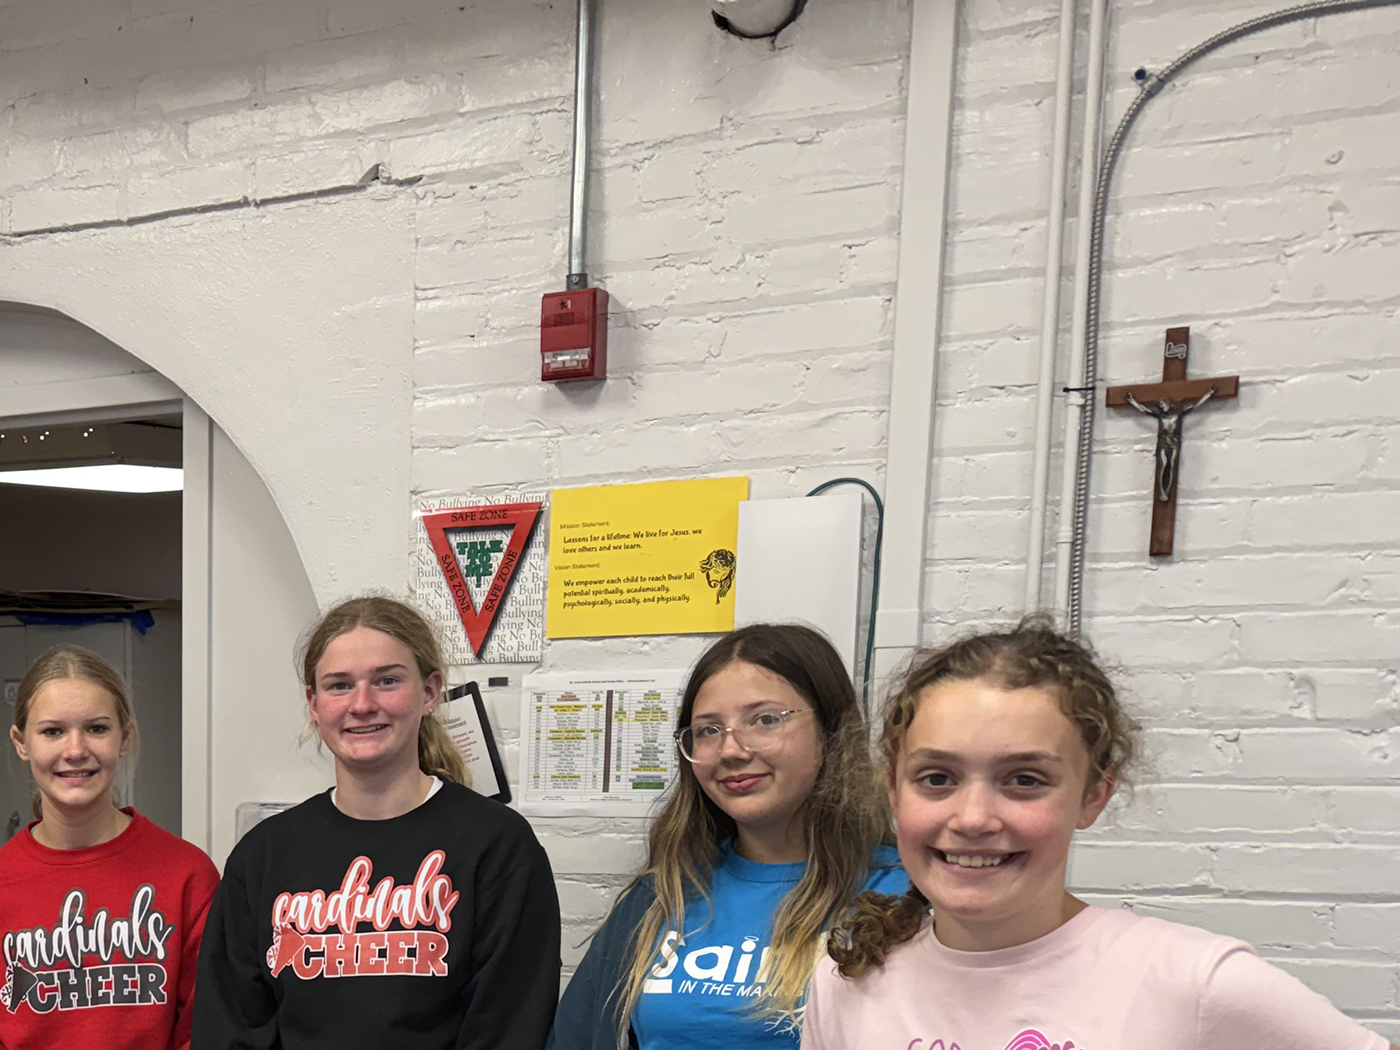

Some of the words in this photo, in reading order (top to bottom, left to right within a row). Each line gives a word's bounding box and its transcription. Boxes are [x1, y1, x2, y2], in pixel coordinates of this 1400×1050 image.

[451, 512, 476, 522] SAFE
[478, 509, 509, 520] ZONE
[563, 536, 589, 544] Lessons
[589, 534, 600, 542] for
[645, 530, 657, 538] live
[658, 529, 669, 537] for
[456, 539, 503, 559] TALK
[578, 545, 598, 553] others
[442, 553, 459, 582] SAFE
[485, 583, 505, 612] SAFE
[497, 550, 518, 582] ZONE
[575, 579, 605, 587] empower
[606, 576, 621, 584] each
[623, 575, 639, 583] child
[648, 573, 666, 581] reach
[667, 573, 683, 581] their
[684, 572, 695, 580] full
[563, 588, 591, 599] potential
[642, 595, 655, 603] and
[271, 849, 460, 934] cardinals
[2, 884, 175, 969] cardinals
[291, 930, 449, 980] CHEER
[26, 962, 168, 1014] CHEER
[678, 979, 698, 993] IN
[700, 982, 735, 995] THE
